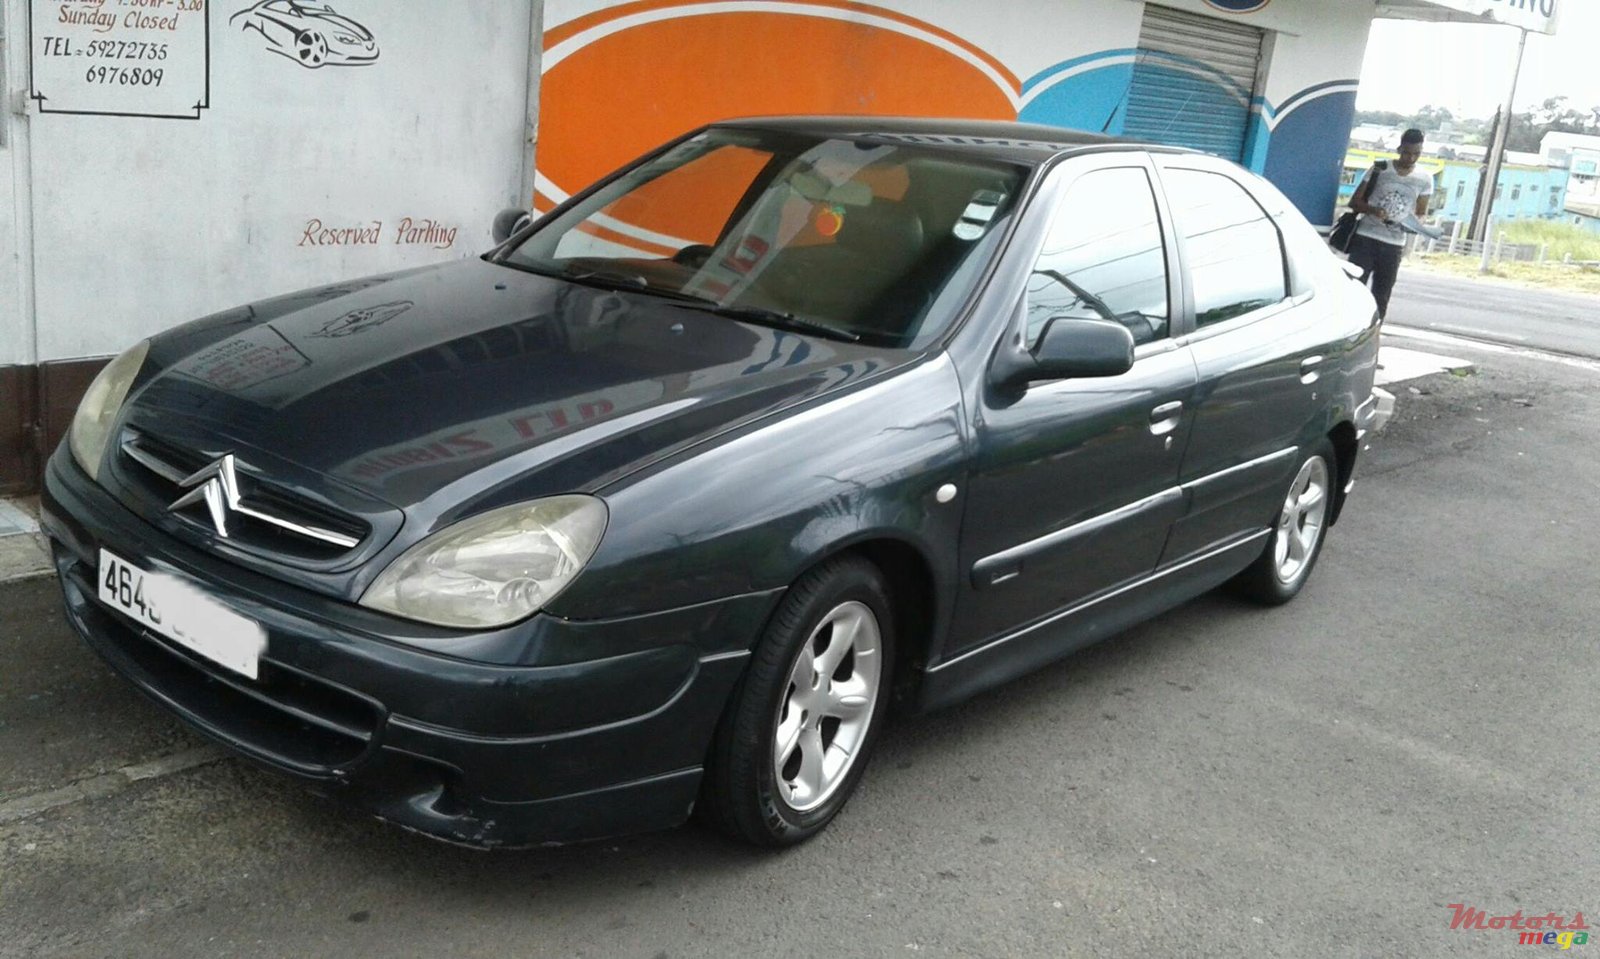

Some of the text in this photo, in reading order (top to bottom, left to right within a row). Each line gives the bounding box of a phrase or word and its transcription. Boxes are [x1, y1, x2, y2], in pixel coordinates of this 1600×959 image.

[58, 4, 179, 33] Sunday Closed
[86, 40, 169, 61] 59272735
[86, 65, 164, 87] 6976809
[298, 218, 382, 247] Reserved
